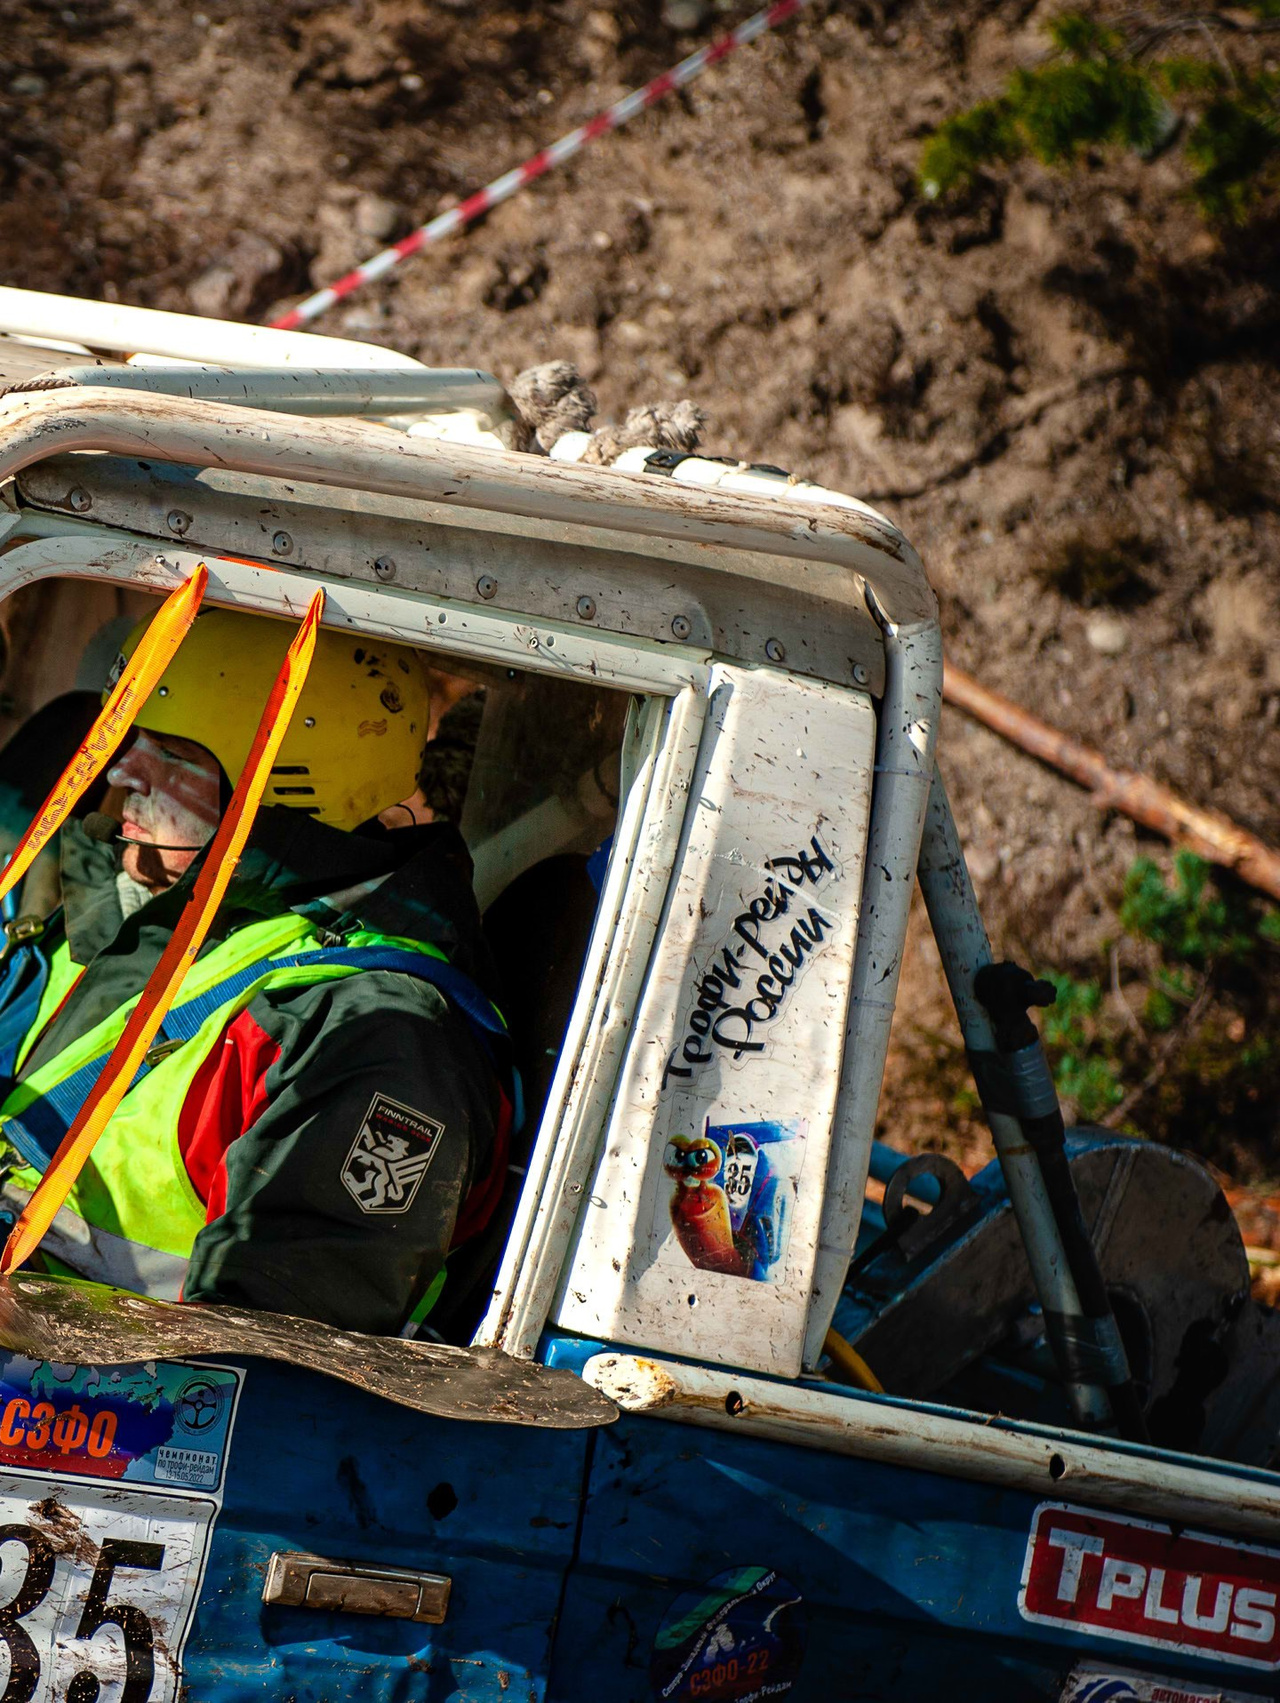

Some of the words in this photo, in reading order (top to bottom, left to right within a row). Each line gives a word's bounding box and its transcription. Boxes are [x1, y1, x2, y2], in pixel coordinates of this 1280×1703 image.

[711, 908, 834, 1060] России
[377, 1105, 433, 1138] FINNTRAIL
[157, 1459, 167, 1468] по
[159, 1449, 217, 1464] чемпионат
[689, 1648, 769, 1696] СЗФО-22
